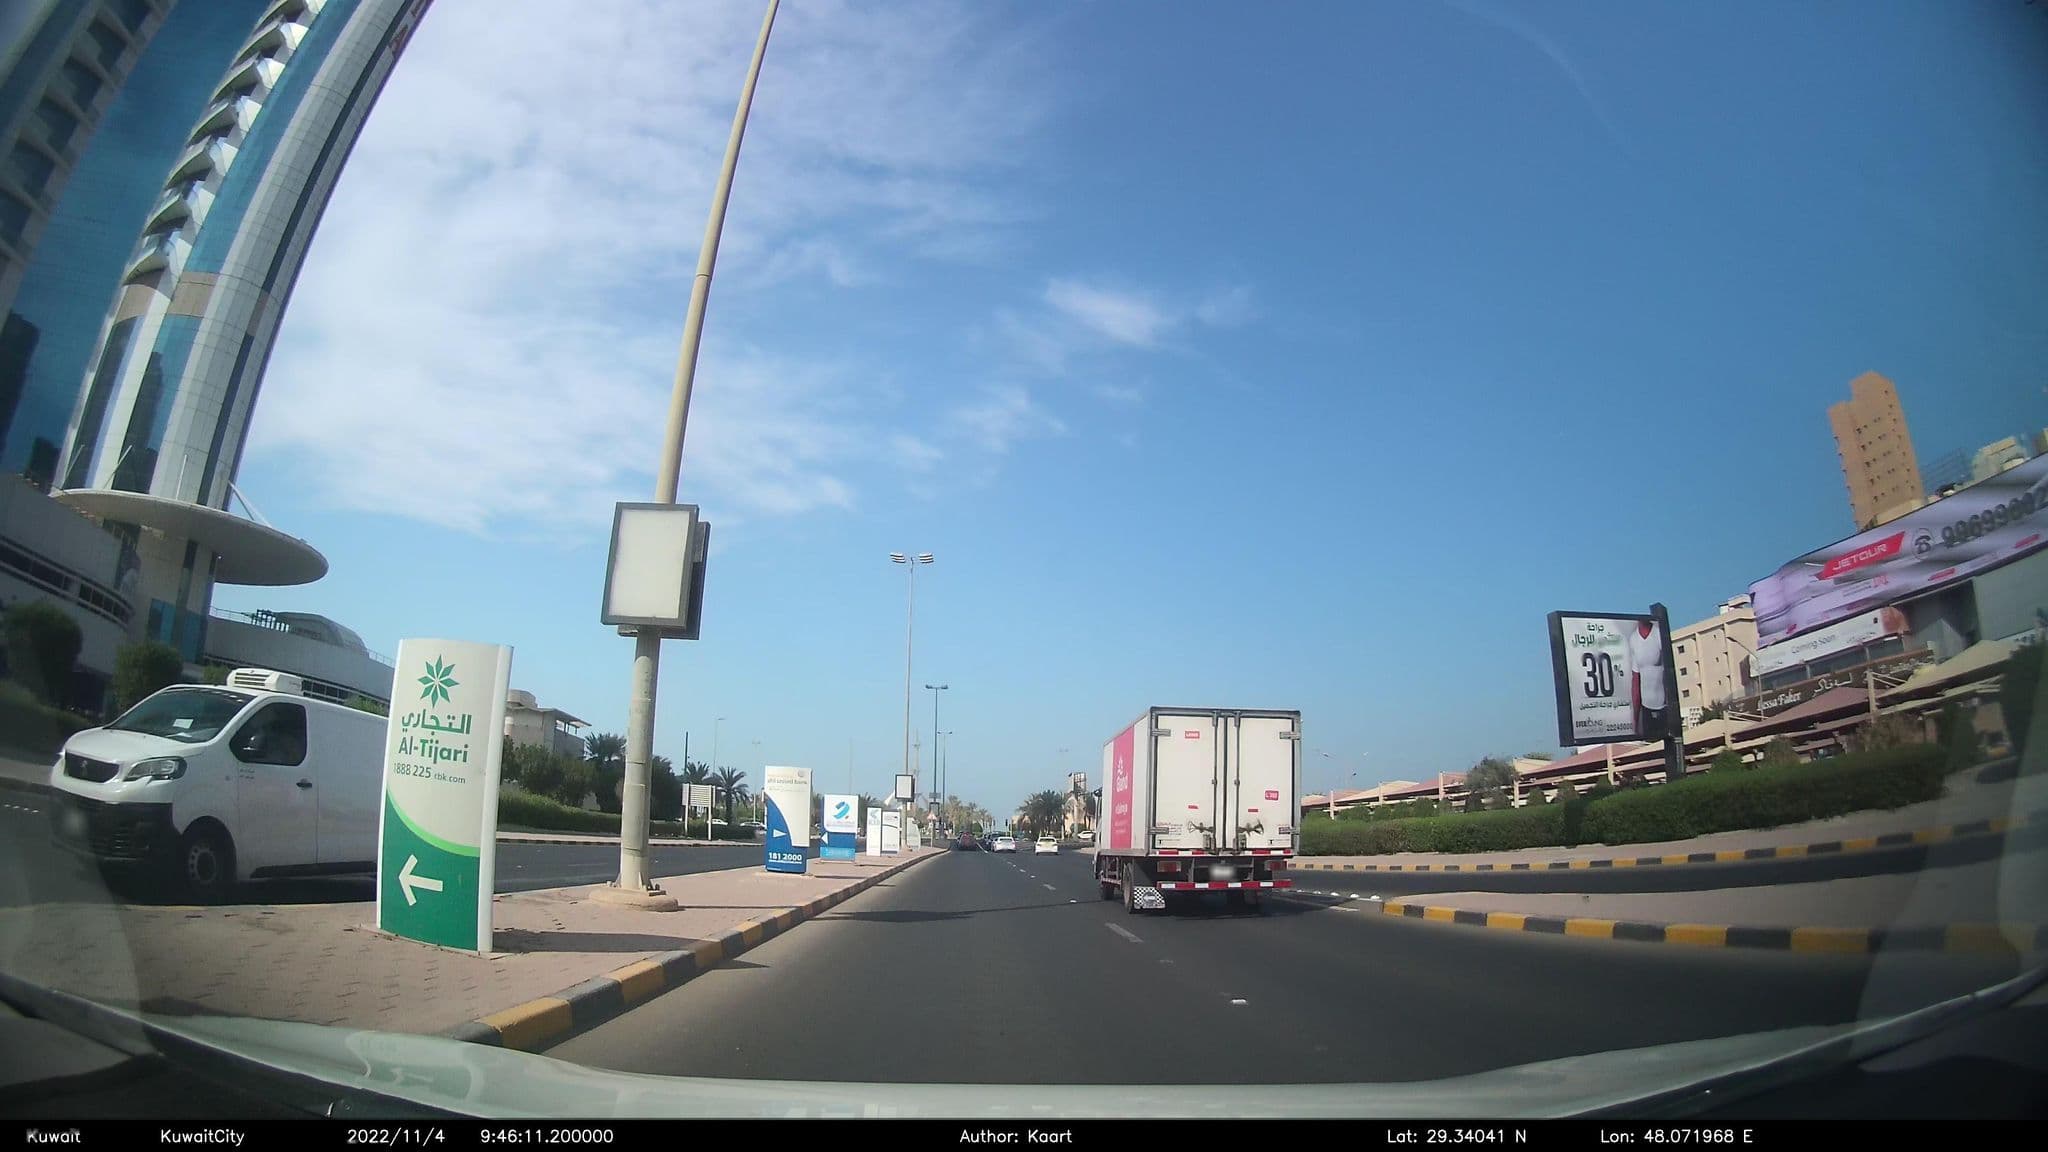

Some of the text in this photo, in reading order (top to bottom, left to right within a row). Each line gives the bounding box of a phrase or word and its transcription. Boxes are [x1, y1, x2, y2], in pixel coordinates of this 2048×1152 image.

[1832, 543, 1888, 571] JETOUR
[401, 708, 472, 736] التجاري
[398, 735, 469, 765] Al-Tijari
[782, 853, 803, 861] 2000
